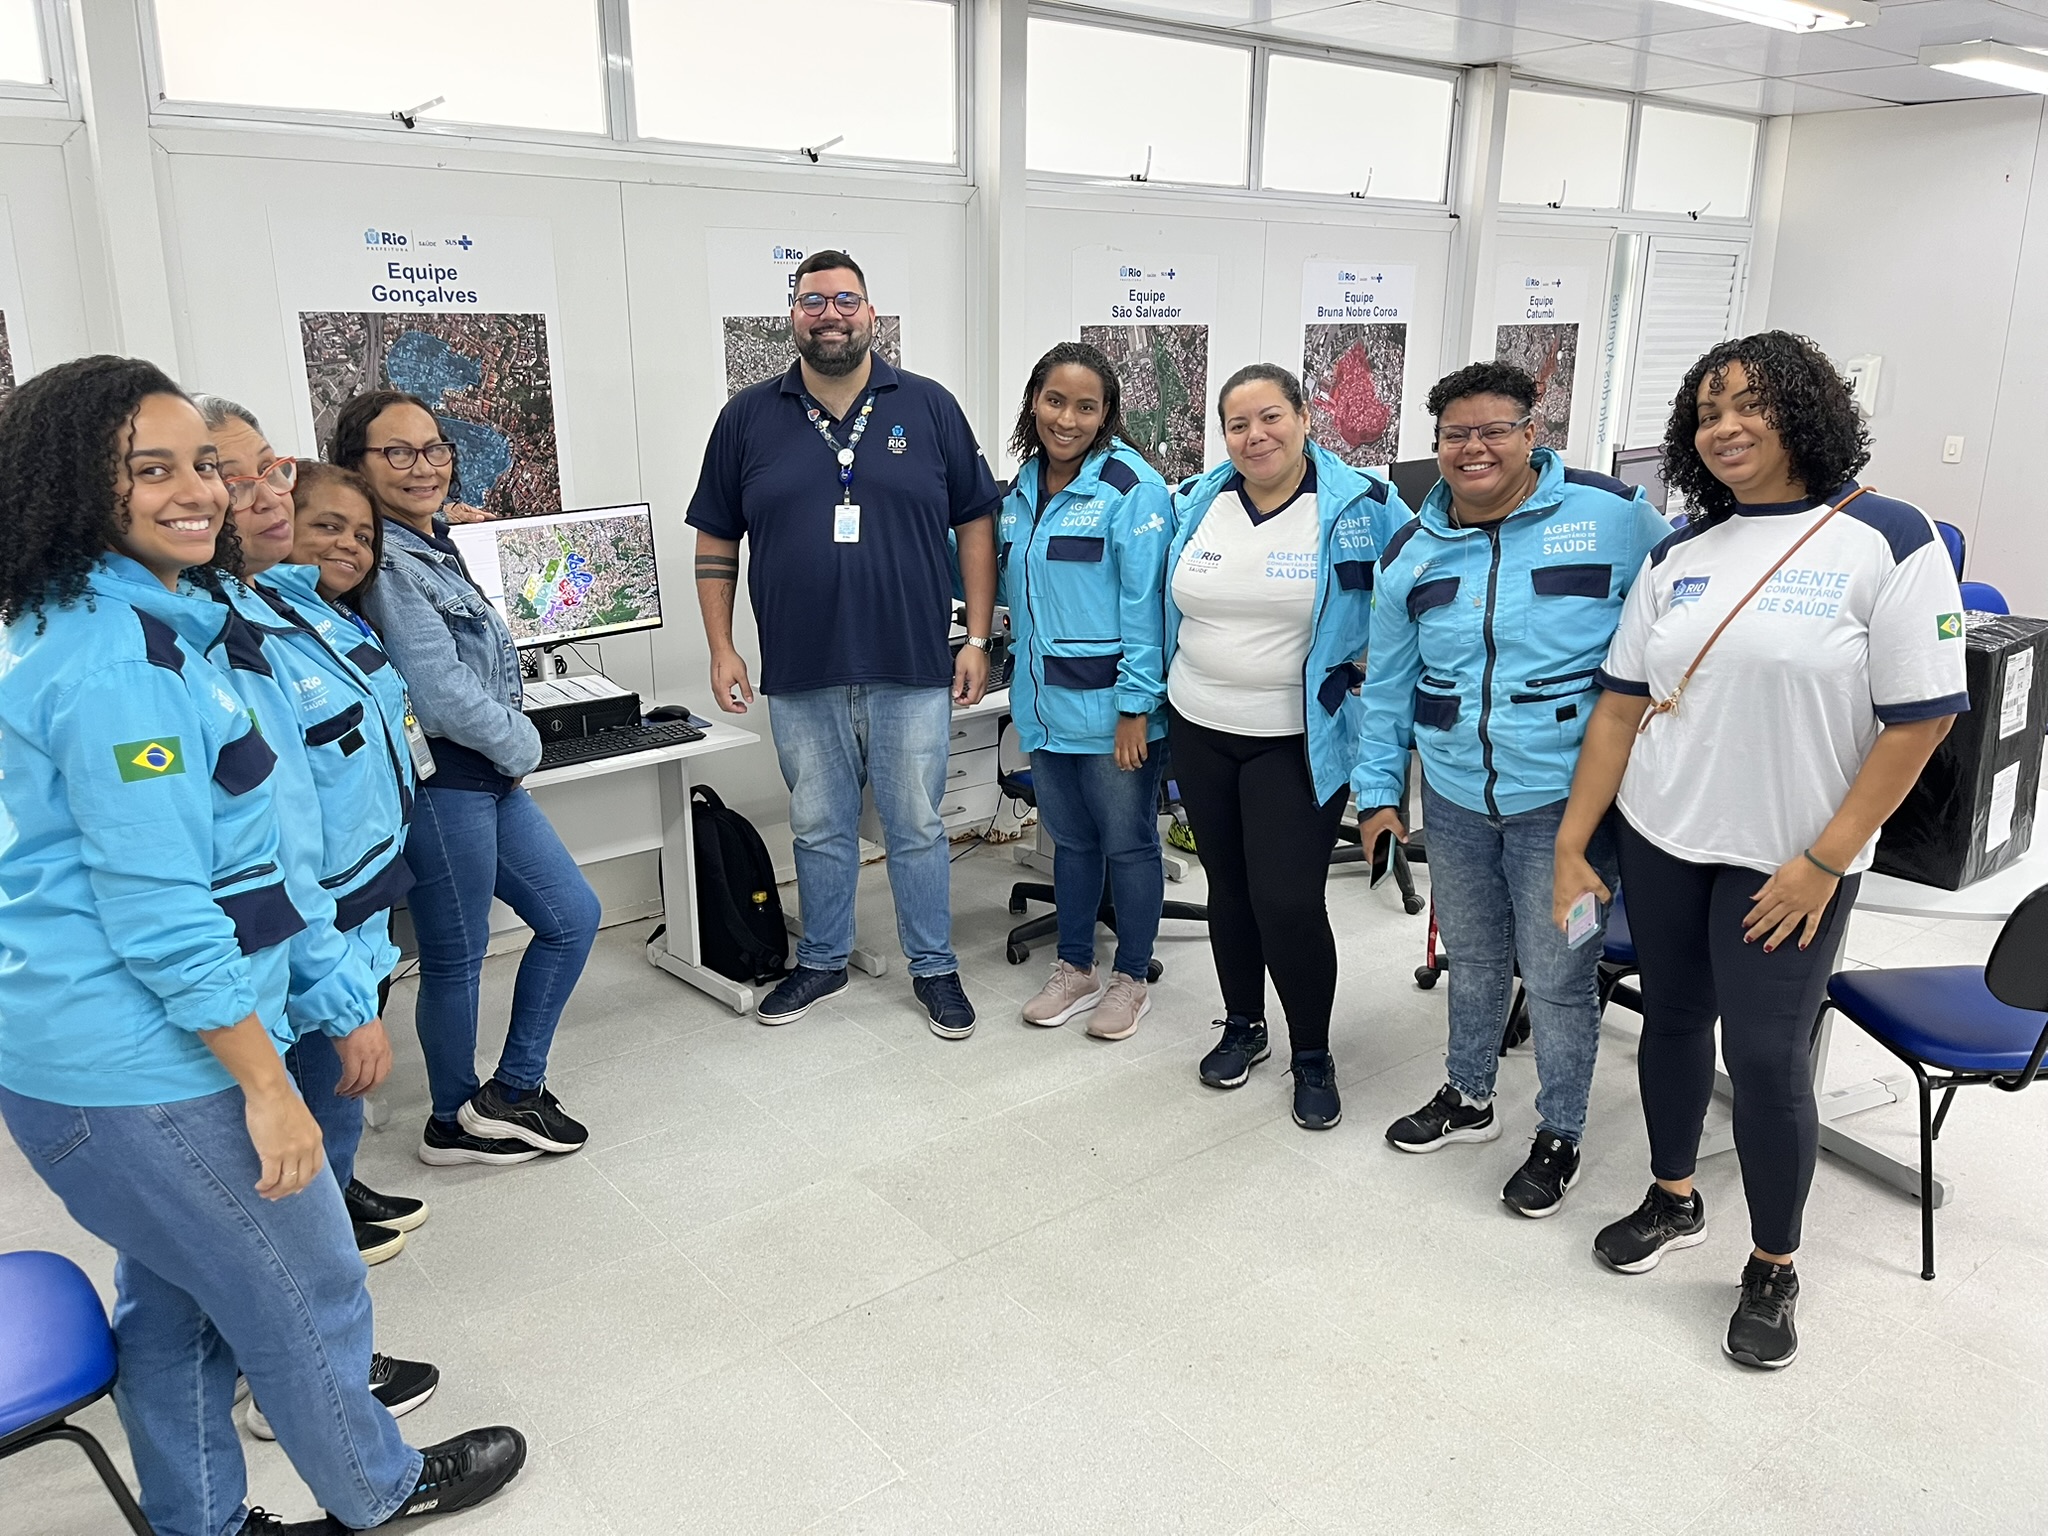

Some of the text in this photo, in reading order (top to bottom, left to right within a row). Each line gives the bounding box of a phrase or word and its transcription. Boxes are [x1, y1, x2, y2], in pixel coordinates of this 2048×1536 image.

[381, 232, 407, 245] Rio
[418, 239, 437, 247] SAÚDE
[785, 248, 804, 260] Rio
[388, 262, 458, 284] Equipe
[1128, 267, 1142, 278] Rio
[1344, 272, 1356, 281] Rio
[1530, 279, 1540, 287] Rio
[371, 284, 478, 307] Gonçalves
[1129, 289, 1166, 304] Equipe
[1344, 291, 1374, 305] Equipe
[1529, 295, 1554, 307] Equipe
[1111, 305, 1182, 318] São Salvador
[1317, 306, 1398, 317] Bruna Nobre Coroa
[1526, 308, 1555, 319] Catumbi
[888, 439, 907, 448] RIO
[1061, 515, 1099, 527] SAÚDE
[1337, 516, 1371, 529] GENTE
[1133, 523, 1149, 536] SUS
[1544, 521, 1597, 535] AGENTE
[1543, 540, 1597, 555] SAÚDE
[1201, 551, 1222, 561] Rio
[1267, 551, 1318, 561] AGENTE
[1265, 567, 1317, 579] SAÚDE
[1769, 569, 1850, 589] AGENTE
[1685, 583, 1706, 593] RIO
[1765, 585, 1843, 599] COMUNITÁRIO
[333, 600, 352, 617] SAÚDE
[1757, 597, 1839, 618] DE SAÚDE
